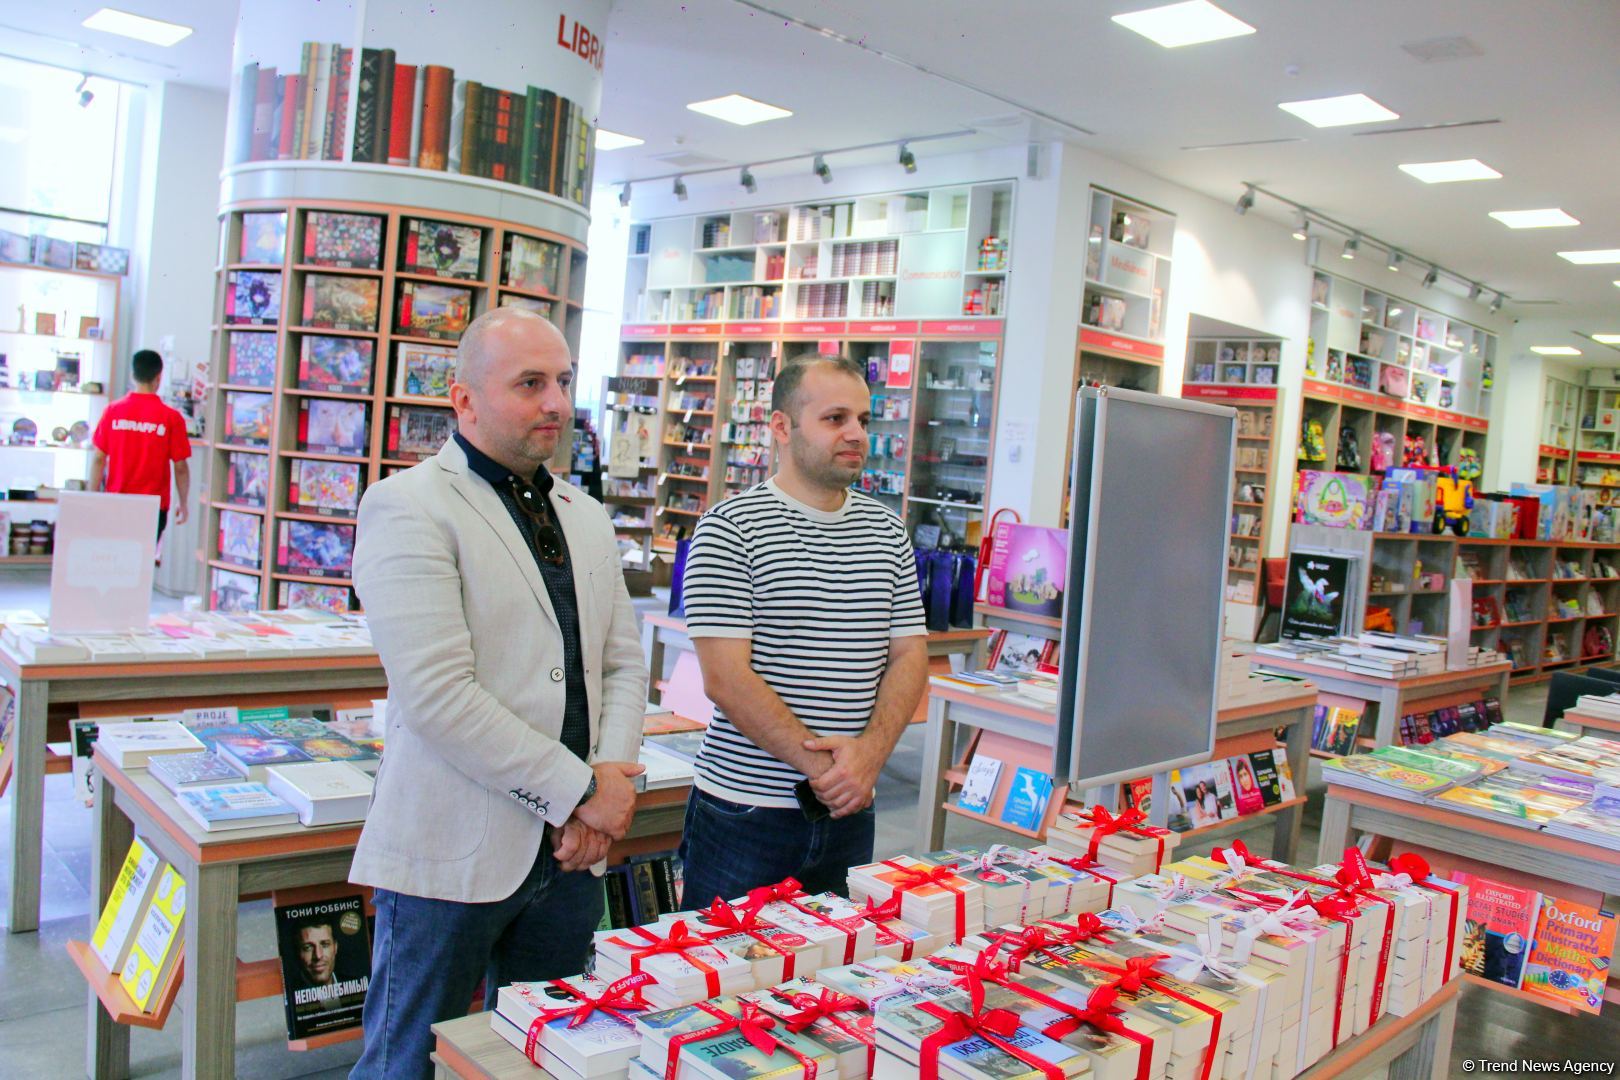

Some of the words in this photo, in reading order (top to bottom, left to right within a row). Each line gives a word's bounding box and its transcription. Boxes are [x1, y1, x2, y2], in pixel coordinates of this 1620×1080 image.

[1476, 892, 1521, 910] ILLUSTRATED
[1485, 888, 1515, 900] OXFORD
[286, 908, 312, 918] ТОНИ
[314, 900, 360, 914] РОББИНС
[1546, 906, 1602, 932] Oxford
[1540, 931, 1599, 955] Illustrated
[1546, 920, 1598, 946] Primary
[1536, 952, 1595, 978] Dictionary
[1546, 944, 1588, 964] Maths
[294, 976, 368, 1004] НЕПОКОЛЕБИМЫЙ
[616, 973, 648, 992] LIBRAFF
